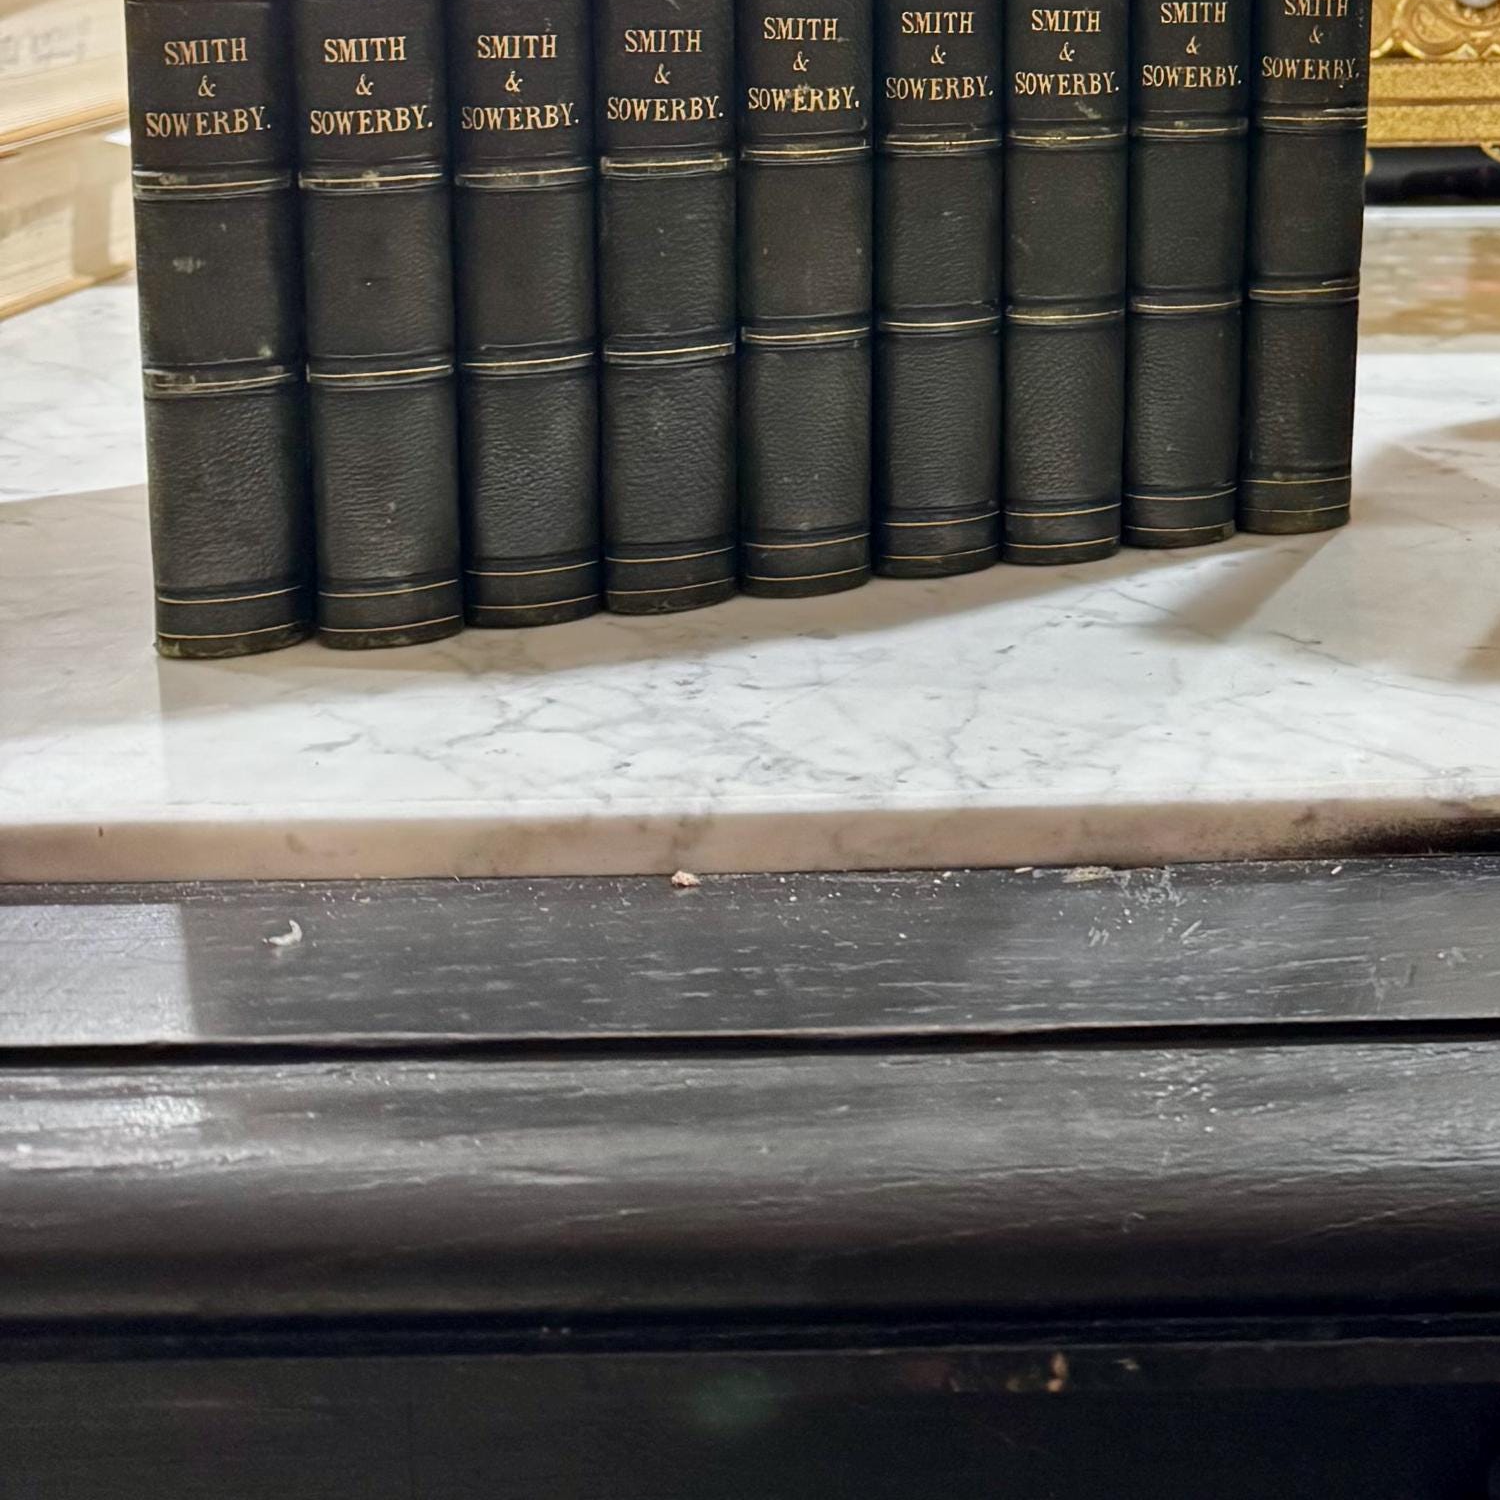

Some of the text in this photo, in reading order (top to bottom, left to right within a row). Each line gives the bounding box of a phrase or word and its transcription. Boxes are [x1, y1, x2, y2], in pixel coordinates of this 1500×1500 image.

[902, 12, 974, 35] SMITH
[1031, 10, 1101, 32] SMITH
[1160, 1, 1227, 24] SMITH
[624, 29, 702, 53] SMITH
[764, 17, 839, 41] SMITH
[1310, 26, 1324, 45] &
[164, 39, 248, 64] SMITH
[324, 37, 407, 62] SMITH
[477, 34, 558, 59] SMITH
[931, 44, 946, 64] &
[1059, 42, 1074, 61] &
[1186, 37, 1201, 55] &
[792, 52, 810, 71] &
[355, 75, 375, 96] &
[505, 71, 523, 92] &
[654, 64, 671, 84] &
[1015, 72, 1119, 96] SOWERBY.
[1142, 65, 1241, 89] SOWERBY.
[198, 77, 217, 97] &
[748, 86, 860, 112] SOWERBY.
[886, 76, 993, 100] SOWERBY.
[310, 106, 433, 136] SOWERBY.
[462, 104, 579, 130] SOWERBY.
[607, 96, 723, 122] SOWERBY.
[146, 107, 271, 137] SOWERBY.
